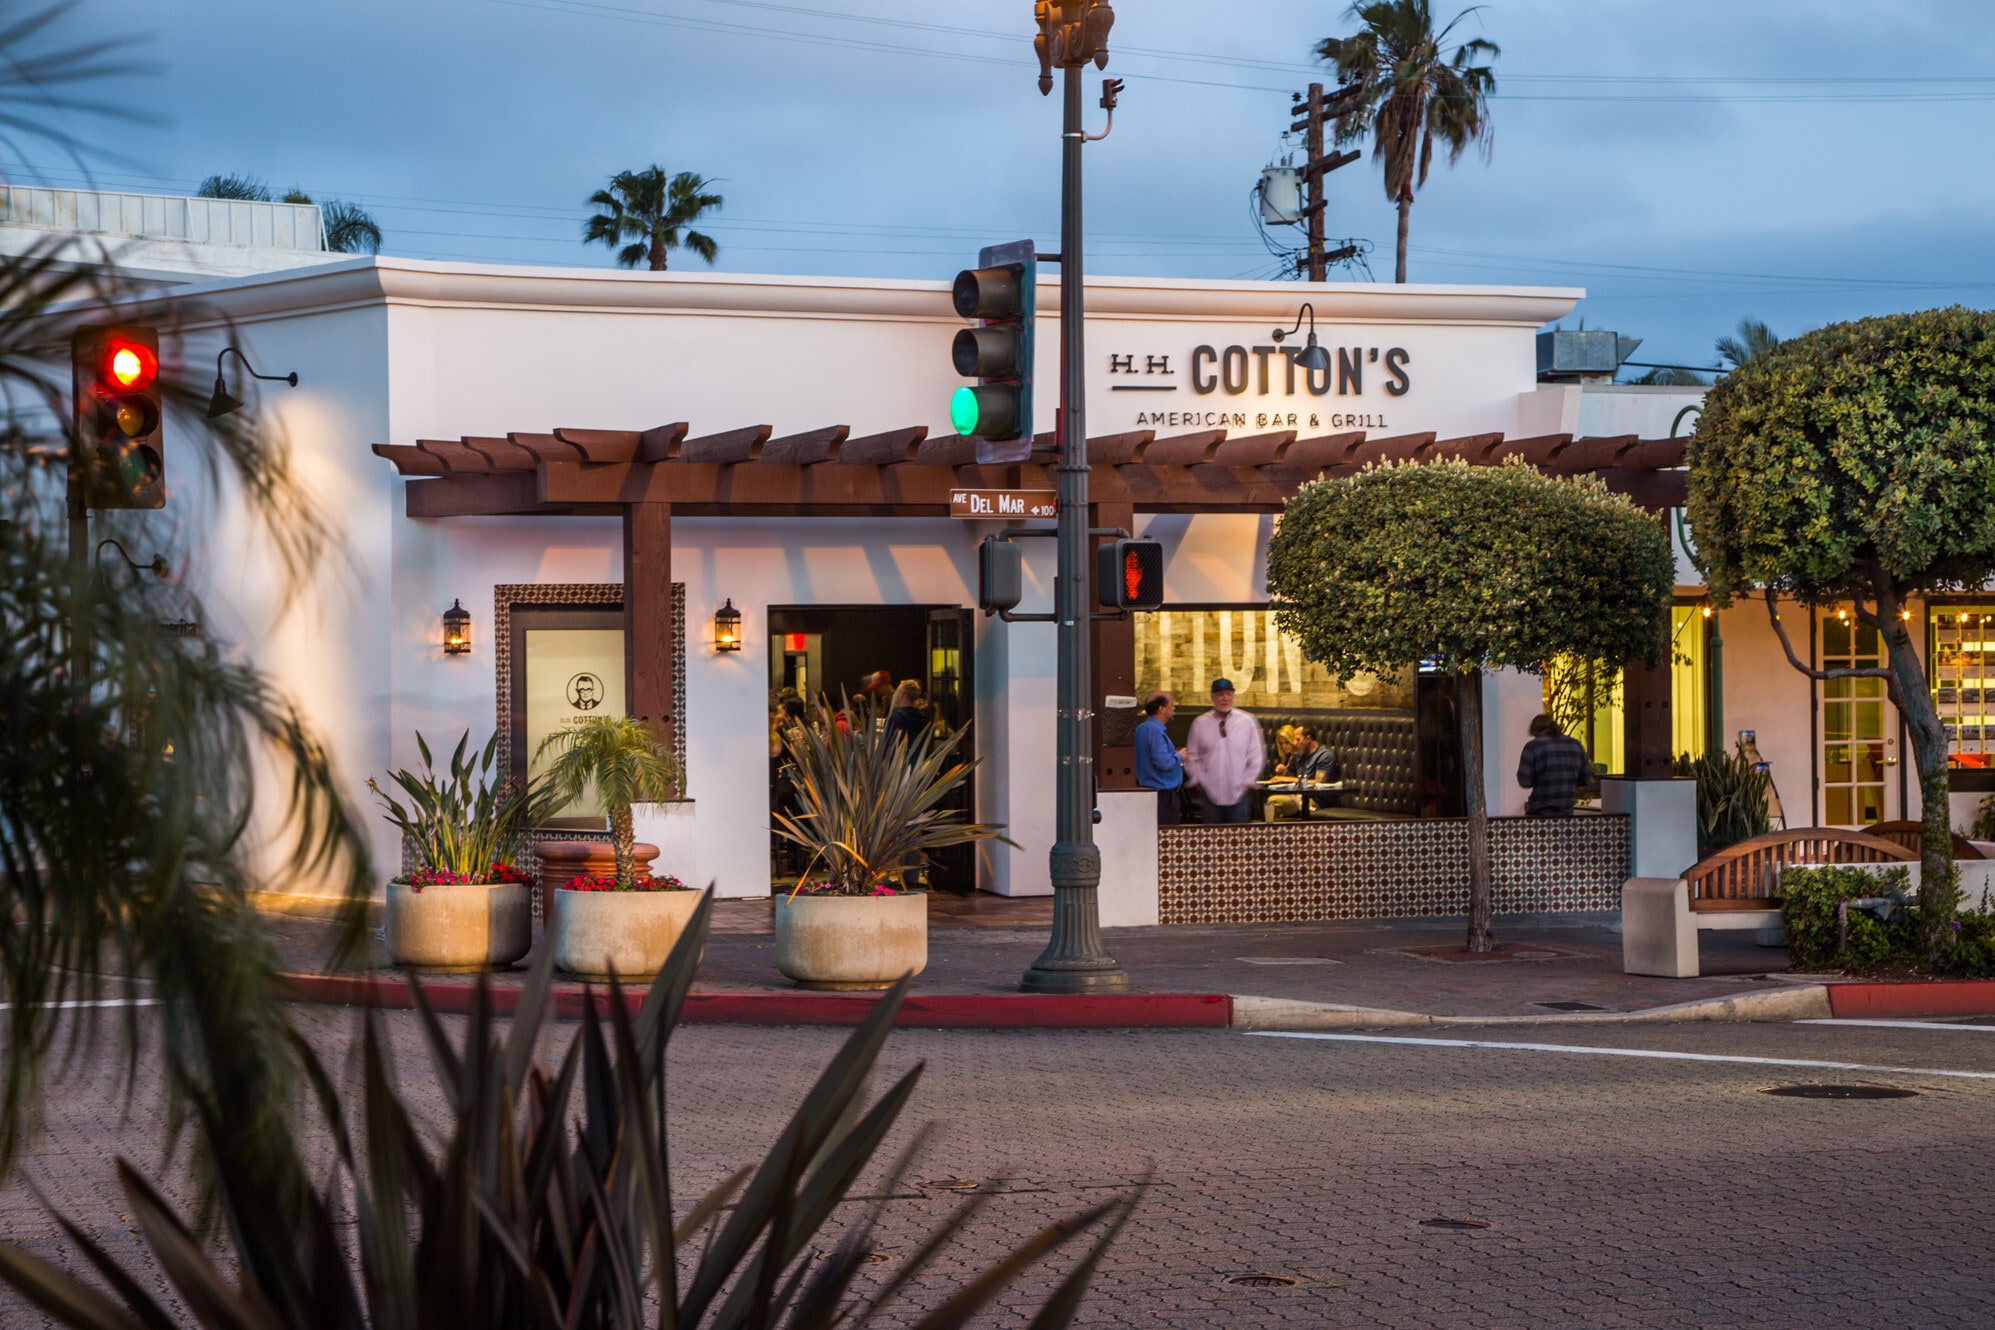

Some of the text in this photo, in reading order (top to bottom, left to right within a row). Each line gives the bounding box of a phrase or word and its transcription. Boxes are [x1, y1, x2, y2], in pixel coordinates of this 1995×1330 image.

[1192, 344, 1410, 396] COTTON'S
[1137, 412, 1388, 428] AMERICAN BAR & GRILL
[952, 493, 967, 504] AVE
